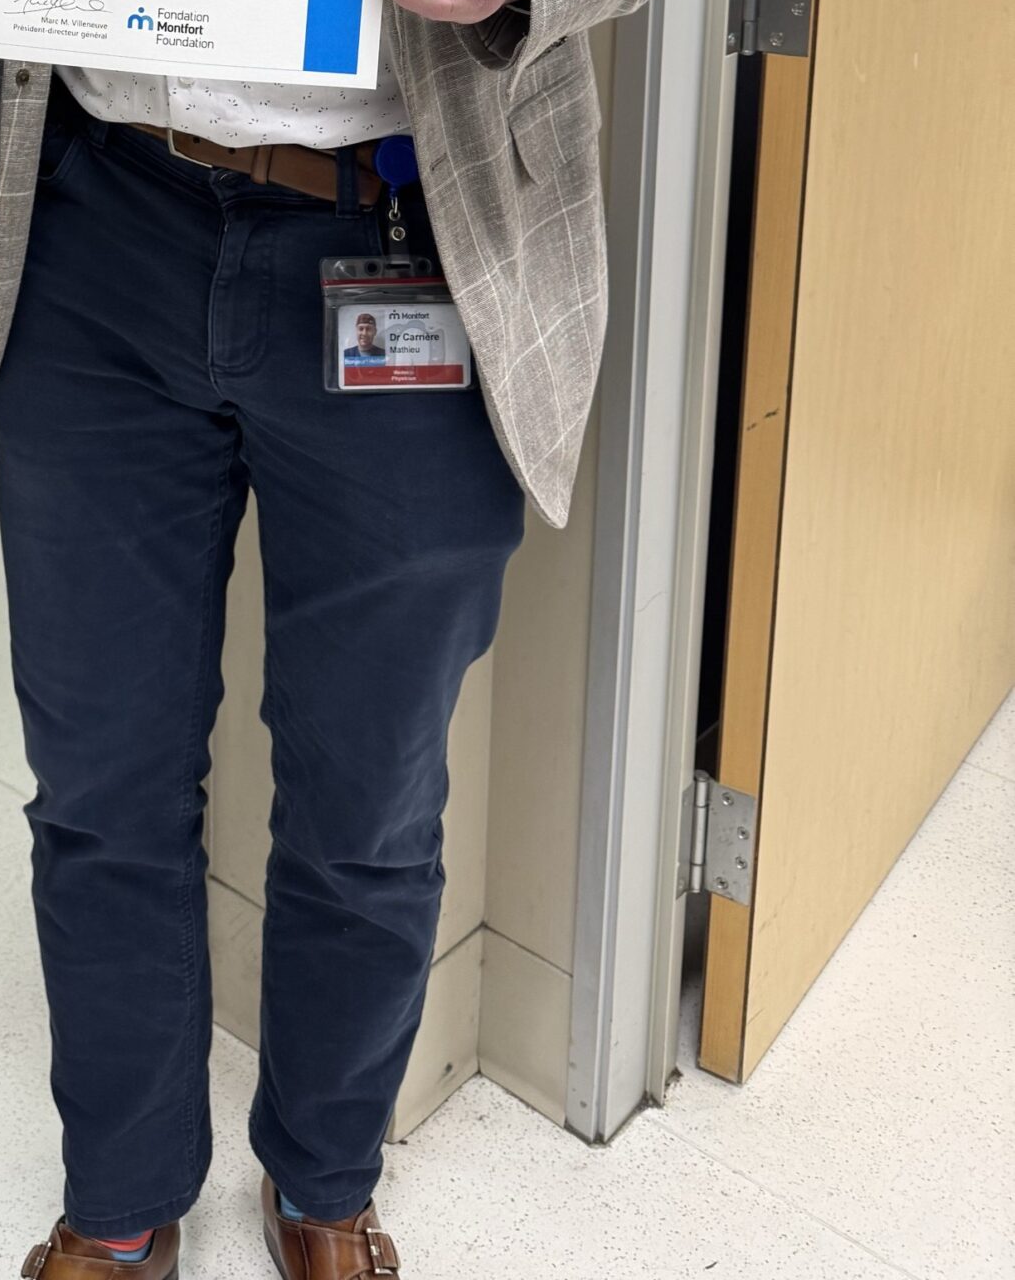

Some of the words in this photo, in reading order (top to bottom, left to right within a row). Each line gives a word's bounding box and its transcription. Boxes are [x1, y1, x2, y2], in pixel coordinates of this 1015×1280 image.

[157, 7, 210, 22] Fondation
[41, 16, 59, 25] Marc
[60, 18, 70, 26] M.
[71, 19, 108, 30] Villeneuve
[156, 21, 204, 35] Montfort
[13, 23, 79, 37] Président-directeur
[80, 31, 108, 40] général
[156, 34, 215, 49] Foundation
[401, 311, 430, 320] Montfort
[389, 333, 400, 342] Dr
[389, 346, 421, 354] Mathieu
